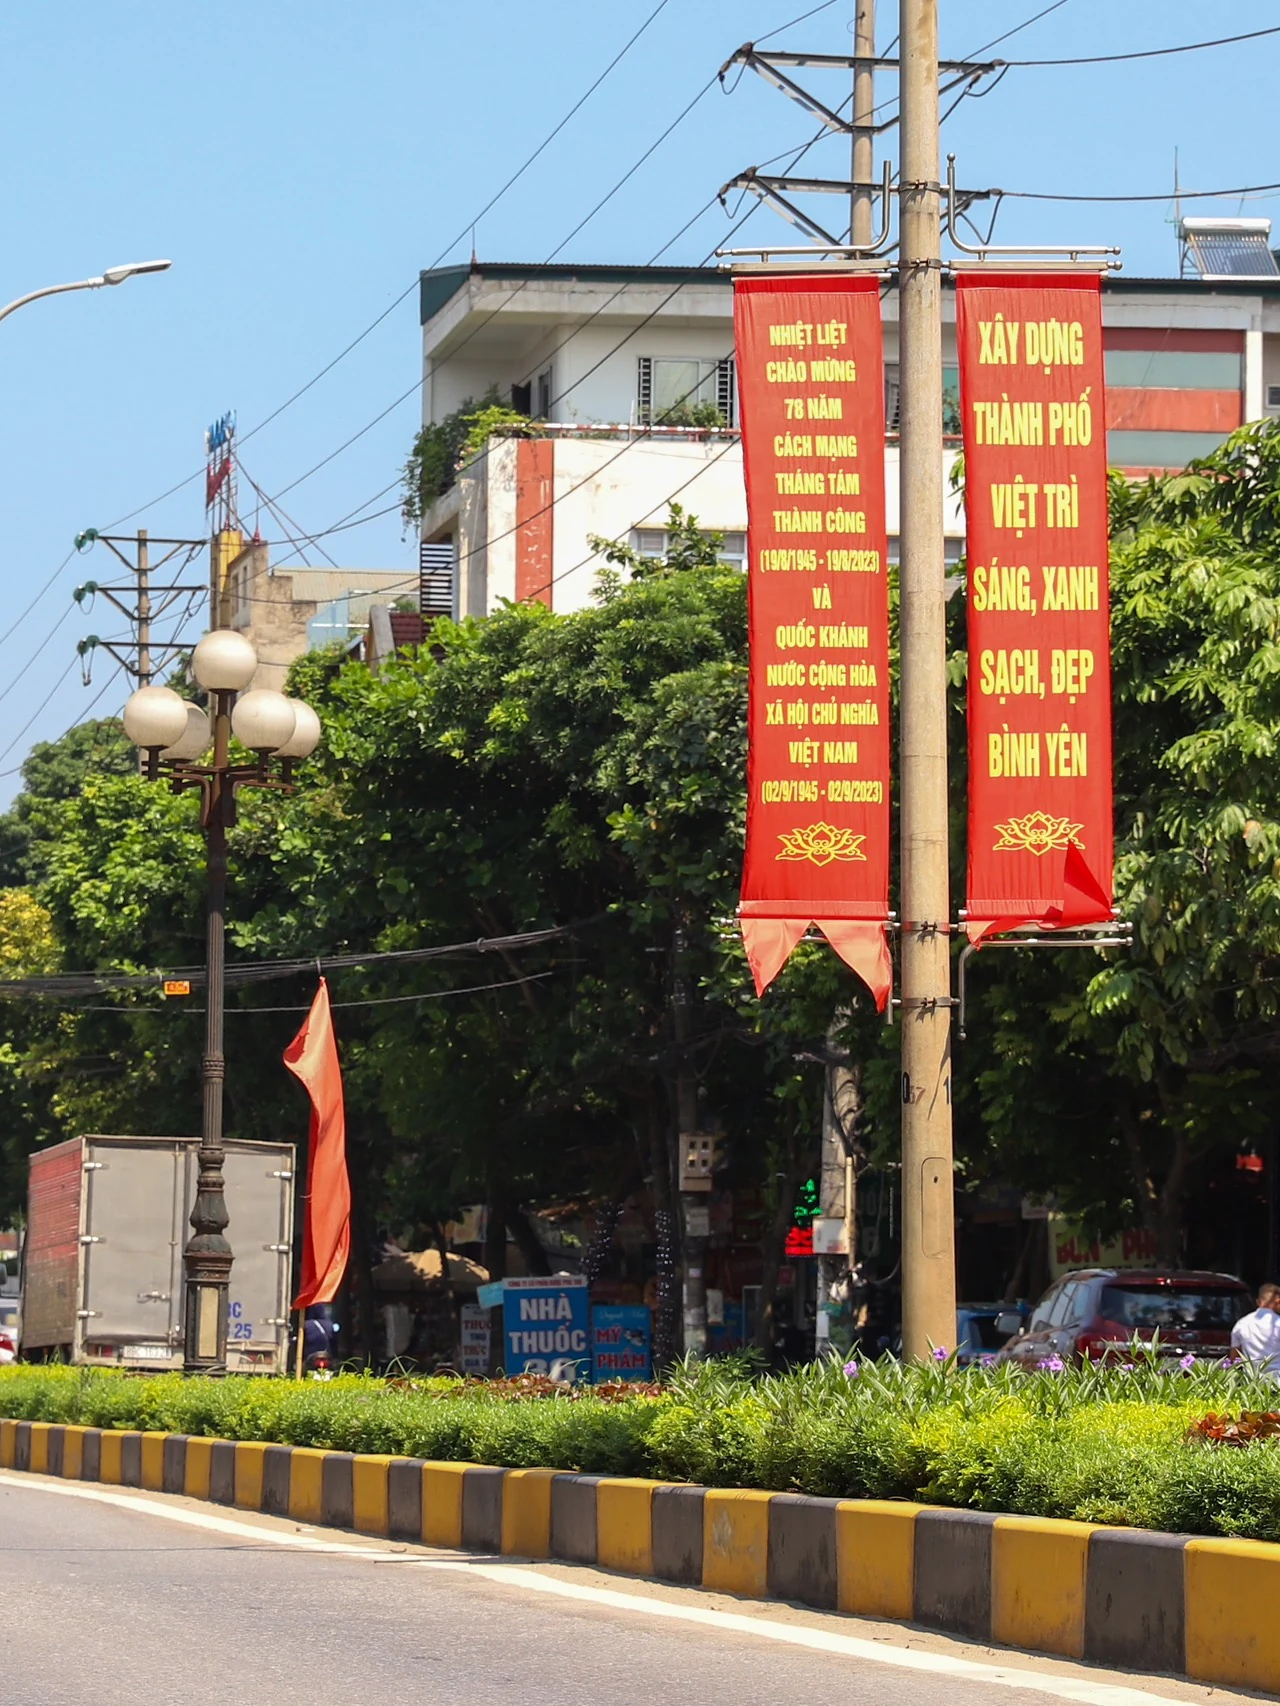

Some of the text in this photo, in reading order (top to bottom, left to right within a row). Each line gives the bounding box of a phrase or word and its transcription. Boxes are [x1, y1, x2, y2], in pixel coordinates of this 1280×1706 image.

[769, 319, 848, 351] NHIỆT LIỆT
[978, 312, 1084, 375] XÂY DỰNG
[766, 356, 856, 383] CHÀO MỪNG
[784, 394, 843, 420] 78 NĂM
[973, 386, 1093, 446] THÀNH PHỐ
[773, 431, 858, 462] CÁCH MẠNG
[775, 469, 861, 496] THÁNG TÁM
[773, 507, 866, 534] THÀNH CÔNG
[991, 474, 1079, 539] VIỆT TRÌ
[759, 549, 817, 574] (19/8/1945
[825, 549, 880, 575] 19/8/2023)
[812, 583, 833, 610] VÀ
[973, 557, 1099, 617] SÁNG, XANH
[776, 618, 869, 650] QUỐC KHÁNH
[766, 659, 877, 691] NƯỚC CỘNG HÒA
[980, 649, 1094, 705] SẠCH, ĐẸP
[765, 696, 880, 730] XÃ HỘI CHỦ NGHĨA
[788, 737, 858, 768] VIỆT NAM
[988, 722, 1088, 778] BÌNH YÊN
[761, 780, 819, 805] (02/9/1945
[827, 780, 883, 805] 02/9/2023)
[520, 1293, 573, 1321] NHÀ
[508, 1322, 587, 1354] THUỐC
